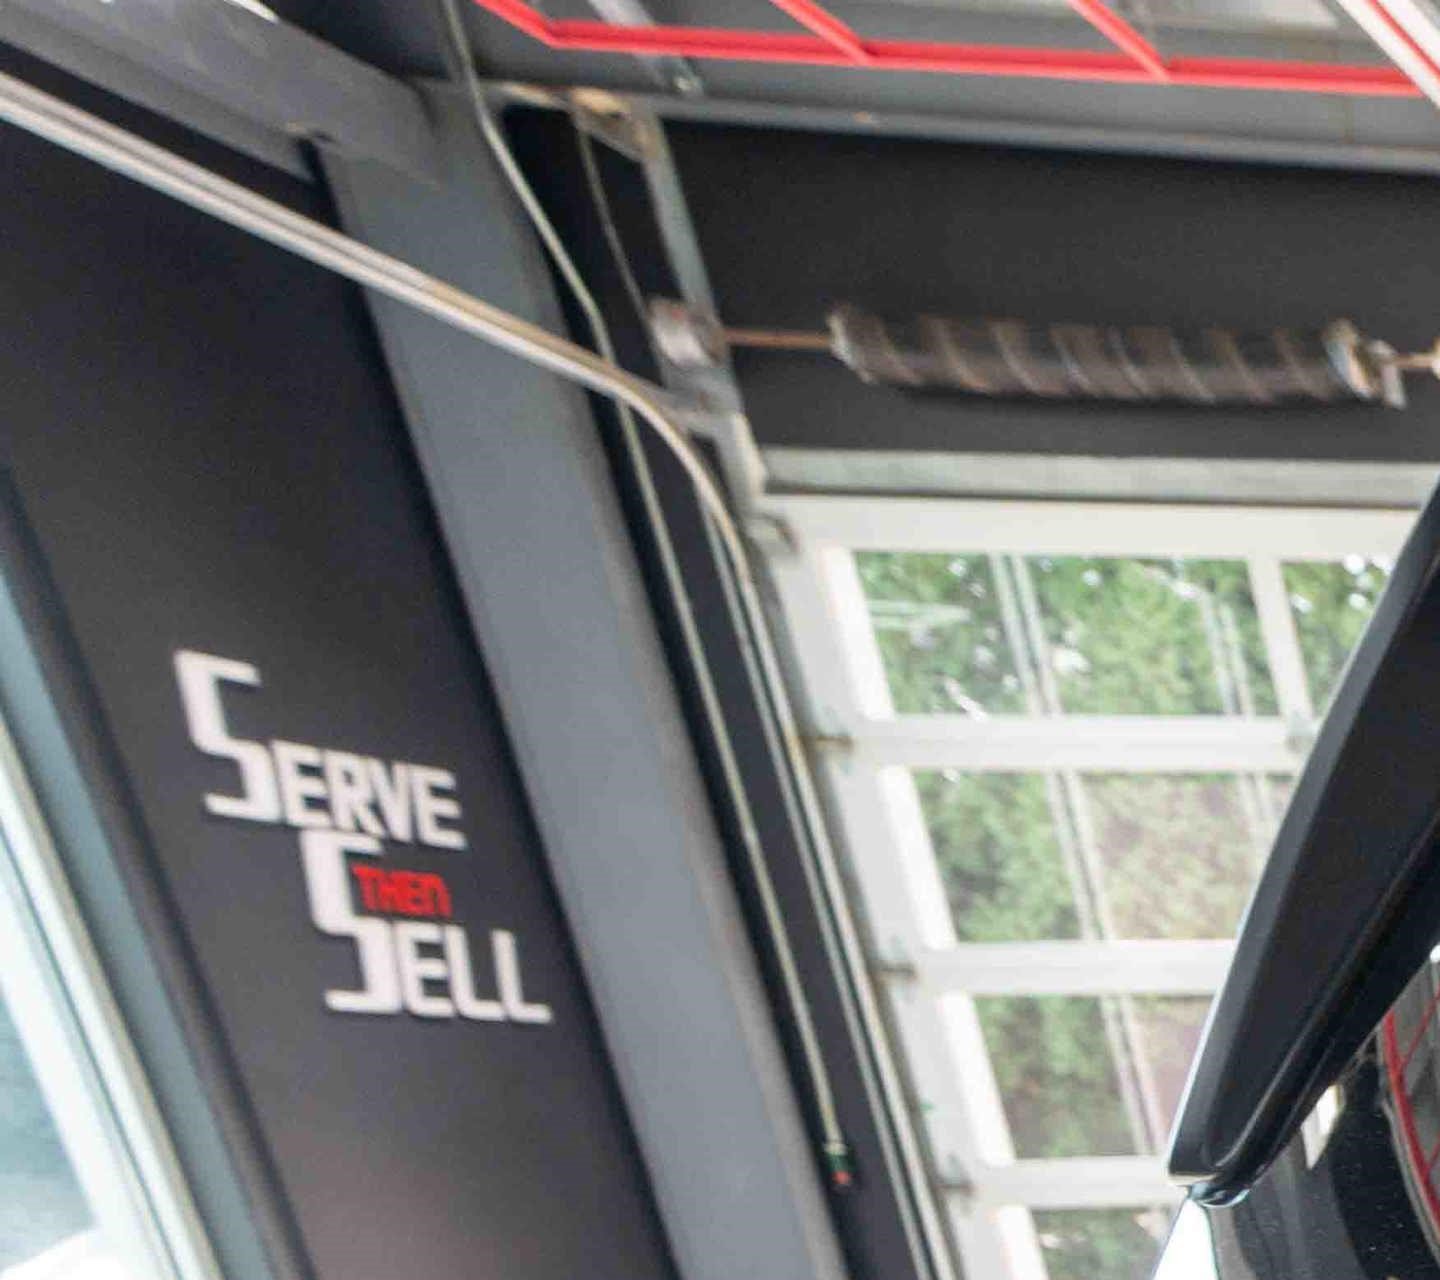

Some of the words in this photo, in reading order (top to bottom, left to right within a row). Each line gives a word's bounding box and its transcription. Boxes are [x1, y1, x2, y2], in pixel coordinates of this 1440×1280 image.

[173, 649, 468, 851] SERVE
[301, 829, 553, 1024] SELL
[350, 864, 453, 917] THEN
